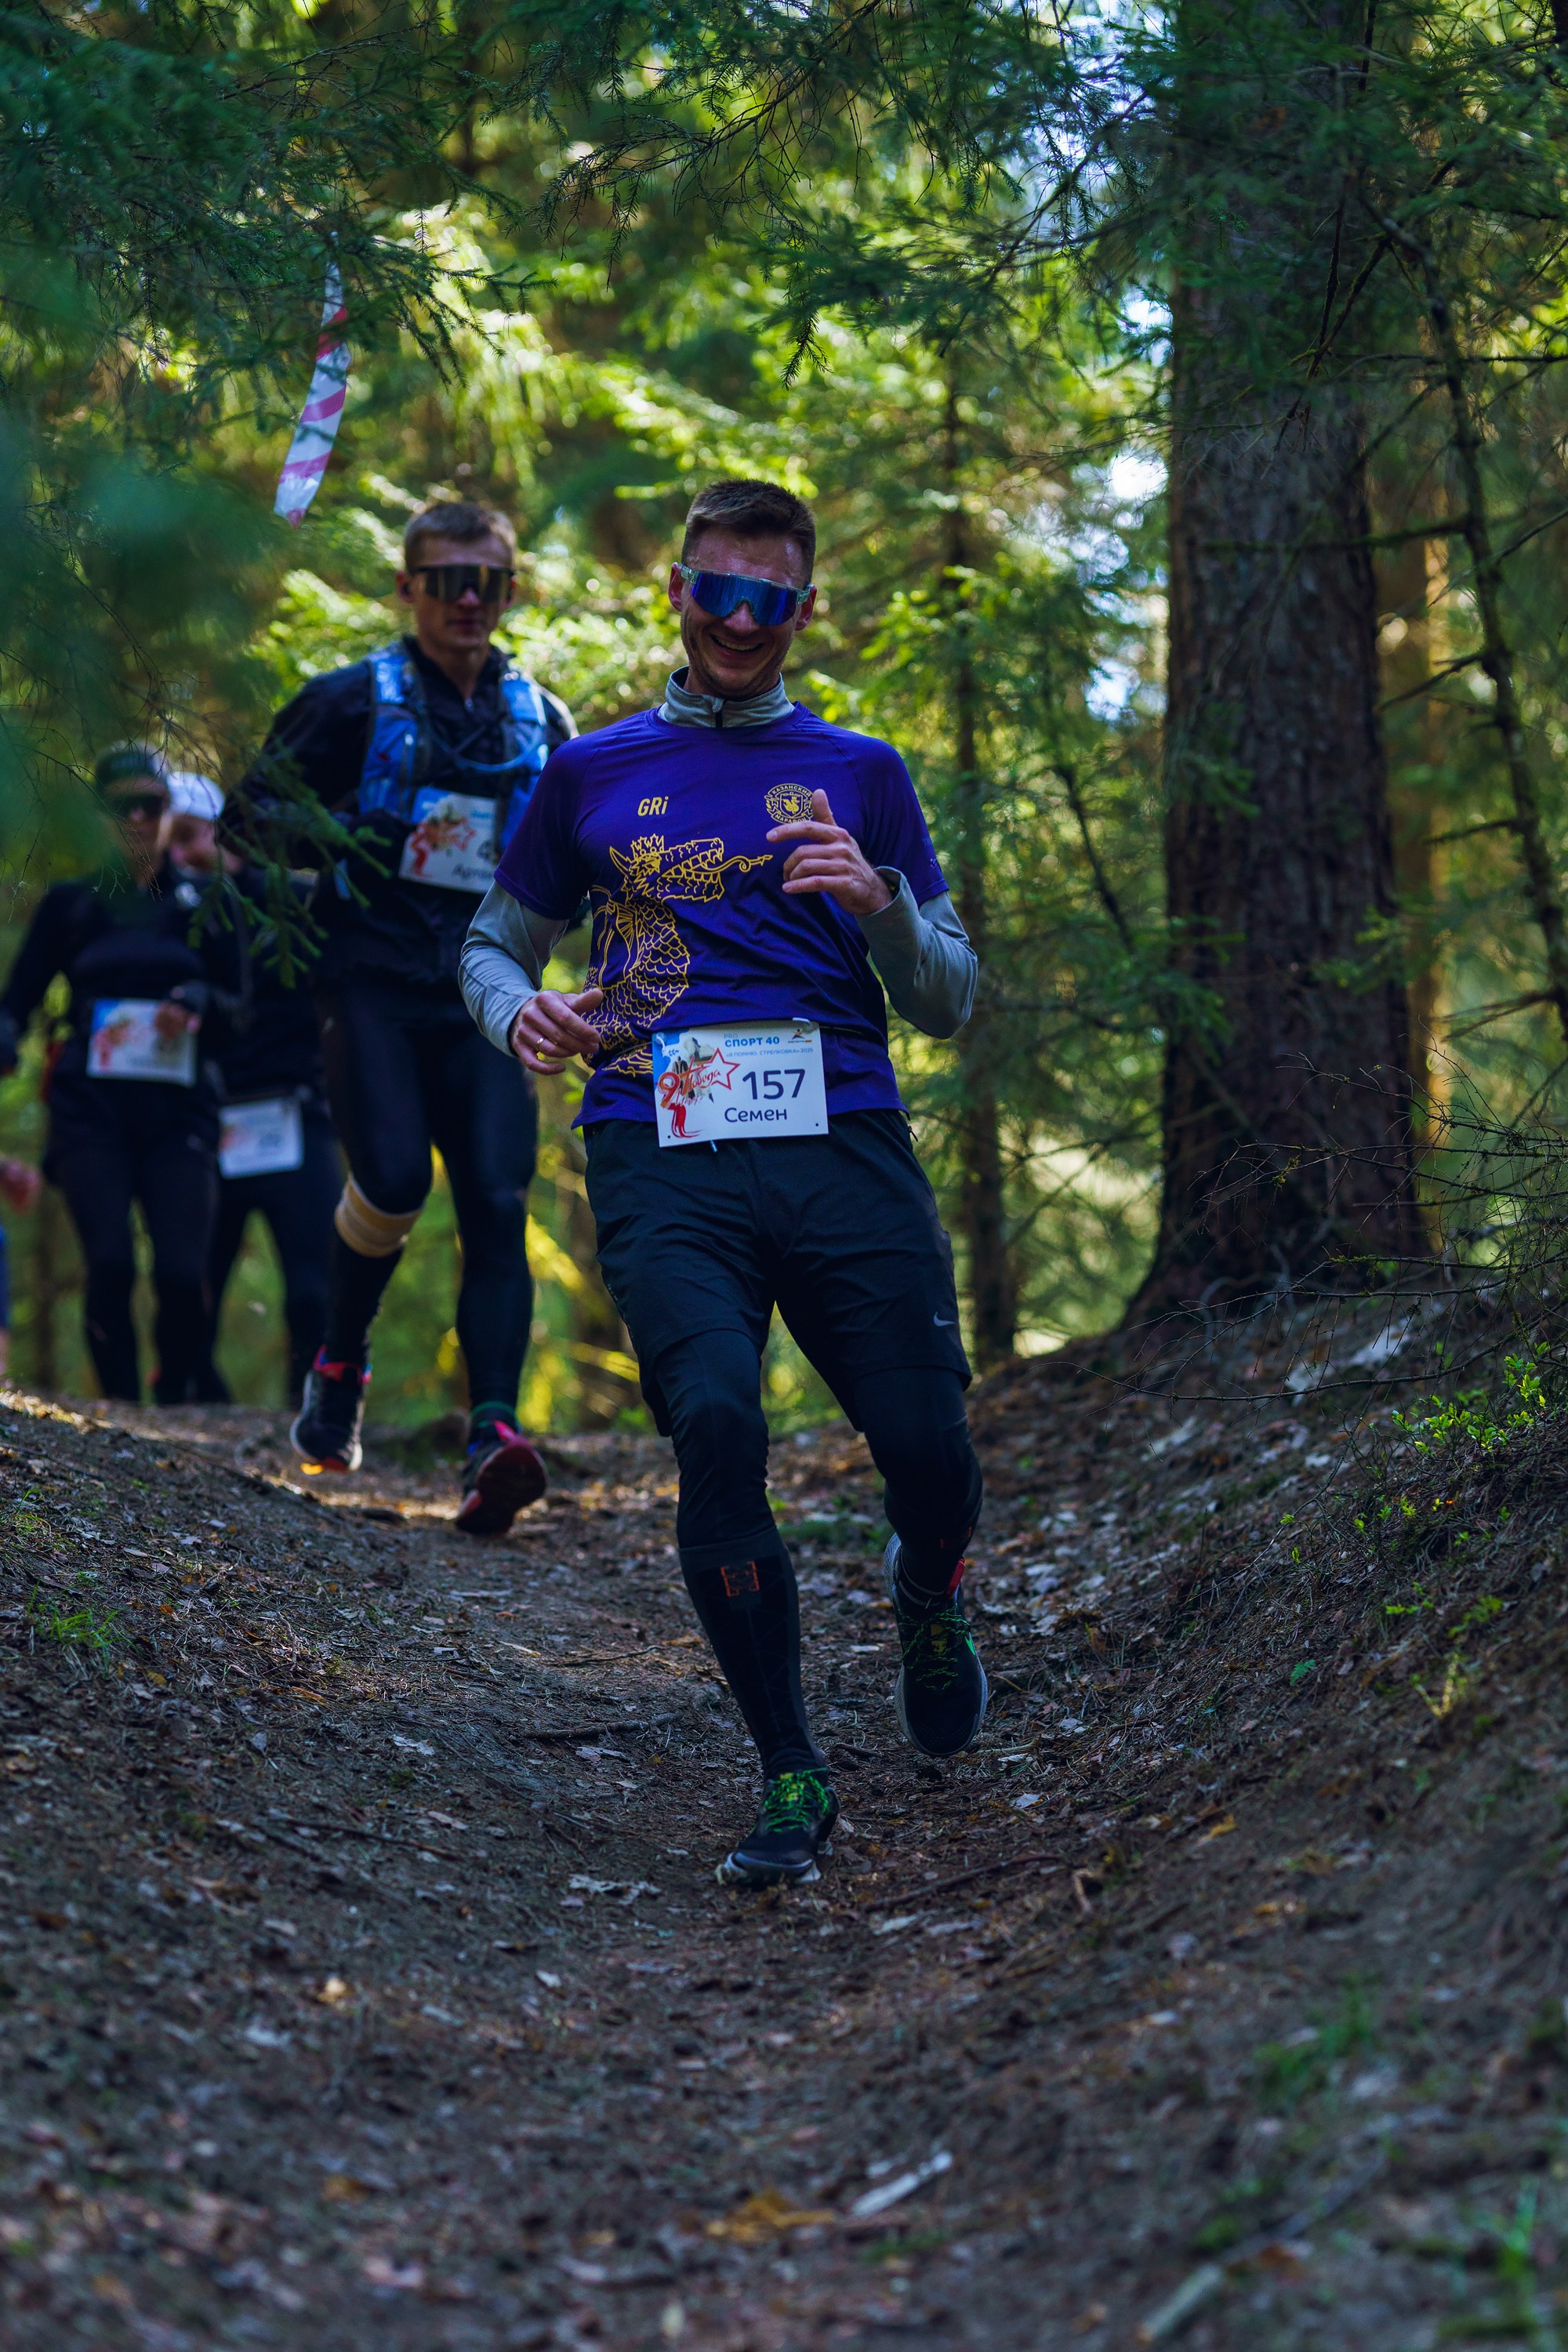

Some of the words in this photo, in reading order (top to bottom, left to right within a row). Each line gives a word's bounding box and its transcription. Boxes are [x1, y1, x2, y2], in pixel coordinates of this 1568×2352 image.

[637, 796, 669, 816] GRi
[725, 1037, 763, 1047] СПОРТ
[658, 1072, 681, 1109] 9
[742, 1069, 806, 1100] 157
[724, 1107, 787, 1123] Семен
